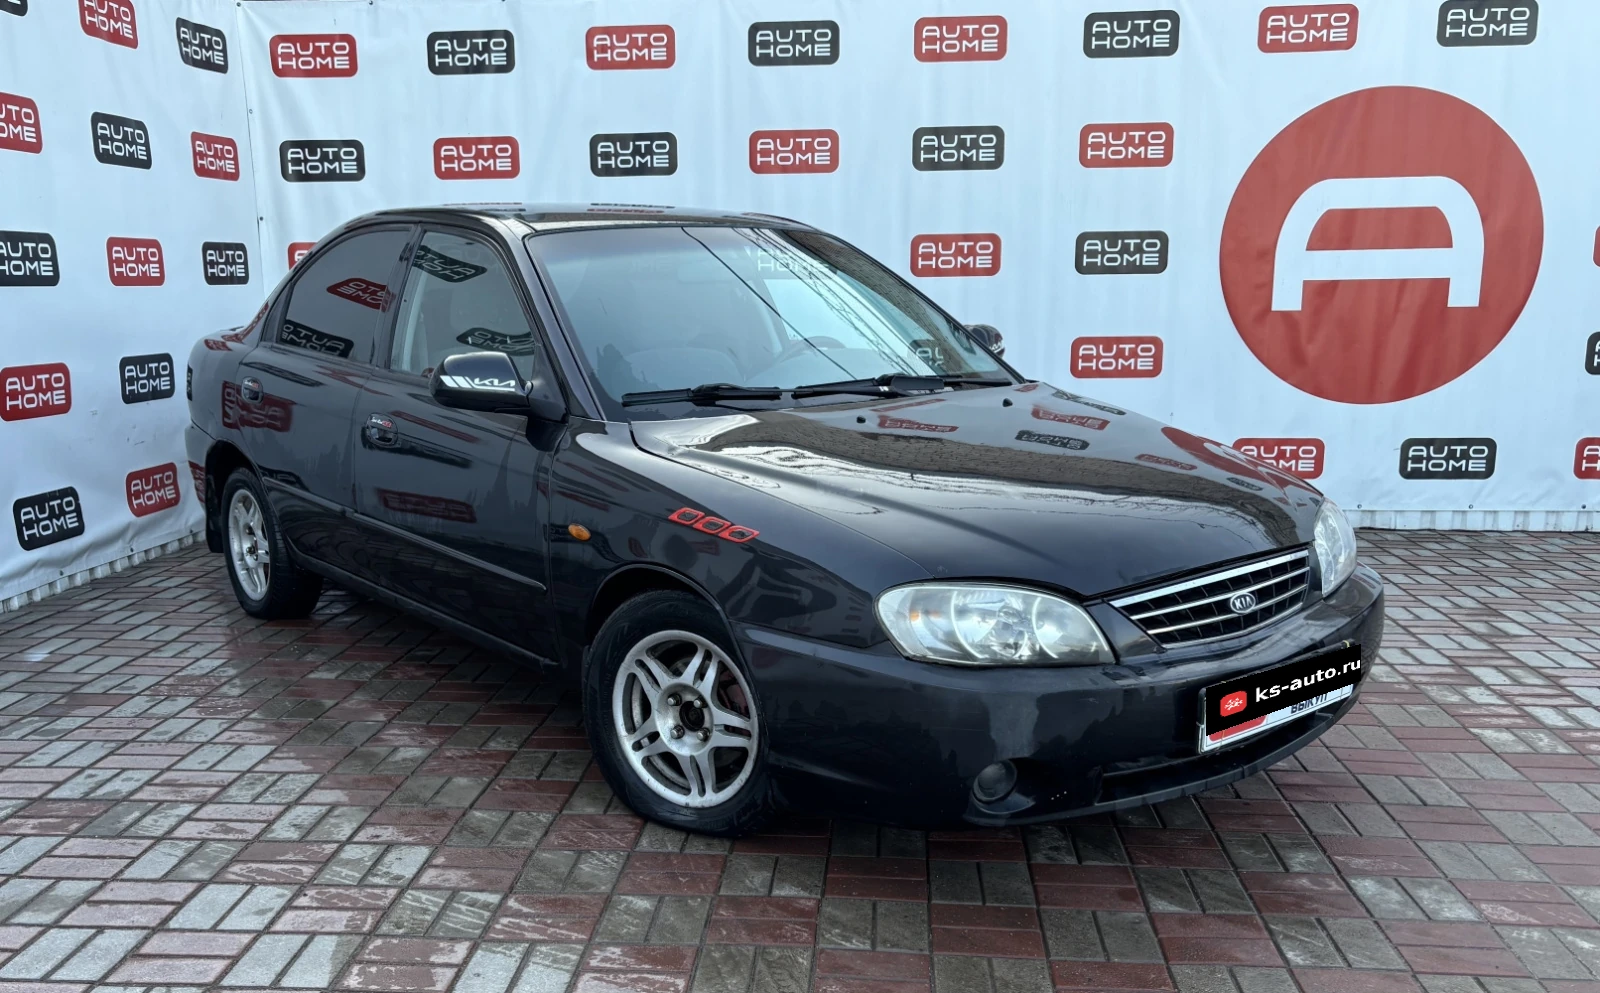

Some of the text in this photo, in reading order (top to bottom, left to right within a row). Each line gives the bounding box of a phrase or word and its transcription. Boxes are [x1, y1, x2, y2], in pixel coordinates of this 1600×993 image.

[1268, 13, 1349, 28] AUTO
[1447, 8, 1530, 22] AUTO
[85, 11, 133, 39] HOME
[923, 25, 999, 38] AUTO
[1093, 19, 1171, 34] AUTO
[1446, 23, 1528, 37] HOME
[180, 27, 222, 49] AUTO
[593, 33, 667, 47] AUTO
[756, 29, 831, 43] AUTO
[1092, 35, 1169, 49] HOME
[1267, 28, 1348, 43] HOME
[278, 42, 349, 55] AUTO
[435, 38, 507, 52] AUTO
[756, 44, 830, 57] HOME
[922, 39, 998, 53] HOME
[181, 43, 224, 64] HOME
[435, 53, 506, 66] HOME
[594, 48, 666, 61] HOME
[278, 57, 349, 69] HOME
[98, 123, 145, 143] AUTO
[1088, 131, 1165, 144] AUTO
[757, 138, 831, 151] AUTO
[921, 134, 996, 147] AUTO
[99, 139, 147, 159] HOME
[196, 141, 233, 158] AUTO
[288, 148, 357, 160] AUTO
[441, 145, 511, 157] AUTO
[598, 141, 669, 154] AUTO
[1088, 146, 1164, 159] HOME
[598, 155, 669, 168] HOME
[757, 152, 830, 165] HOME
[921, 149, 995, 162] HOME
[197, 156, 235, 172] HOME
[288, 162, 357, 174] HOME
[441, 159, 511, 171] HOME
[919, 242, 993, 254] AUTO
[1084, 239, 1160, 252] AUTO
[112, 247, 158, 261] AUTO
[207, 250, 244, 262] AUTO
[1083, 254, 1159, 266] HOME
[918, 256, 992, 268] HOME
[114, 263, 160, 276] HOME
[208, 265, 245, 276] HOME
[1079, 344, 1155, 356] AUTO
[125, 362, 169, 379] AUTO
[1079, 358, 1153, 370] HOME
[6, 373, 65, 392] AUTO
[126, 377, 170, 394] HOME
[7, 390, 65, 410] HOME
[1240, 446, 1316, 457] AUTO
[1409, 446, 1488, 457] AUTO
[1407, 460, 1486, 471] HOME
[131, 472, 173, 493] AUTO
[132, 486, 176, 508] HOME
[21, 497, 75, 523] AUTO
[23, 513, 78, 540] HOME
[1234, 596, 1253, 609] KIA
